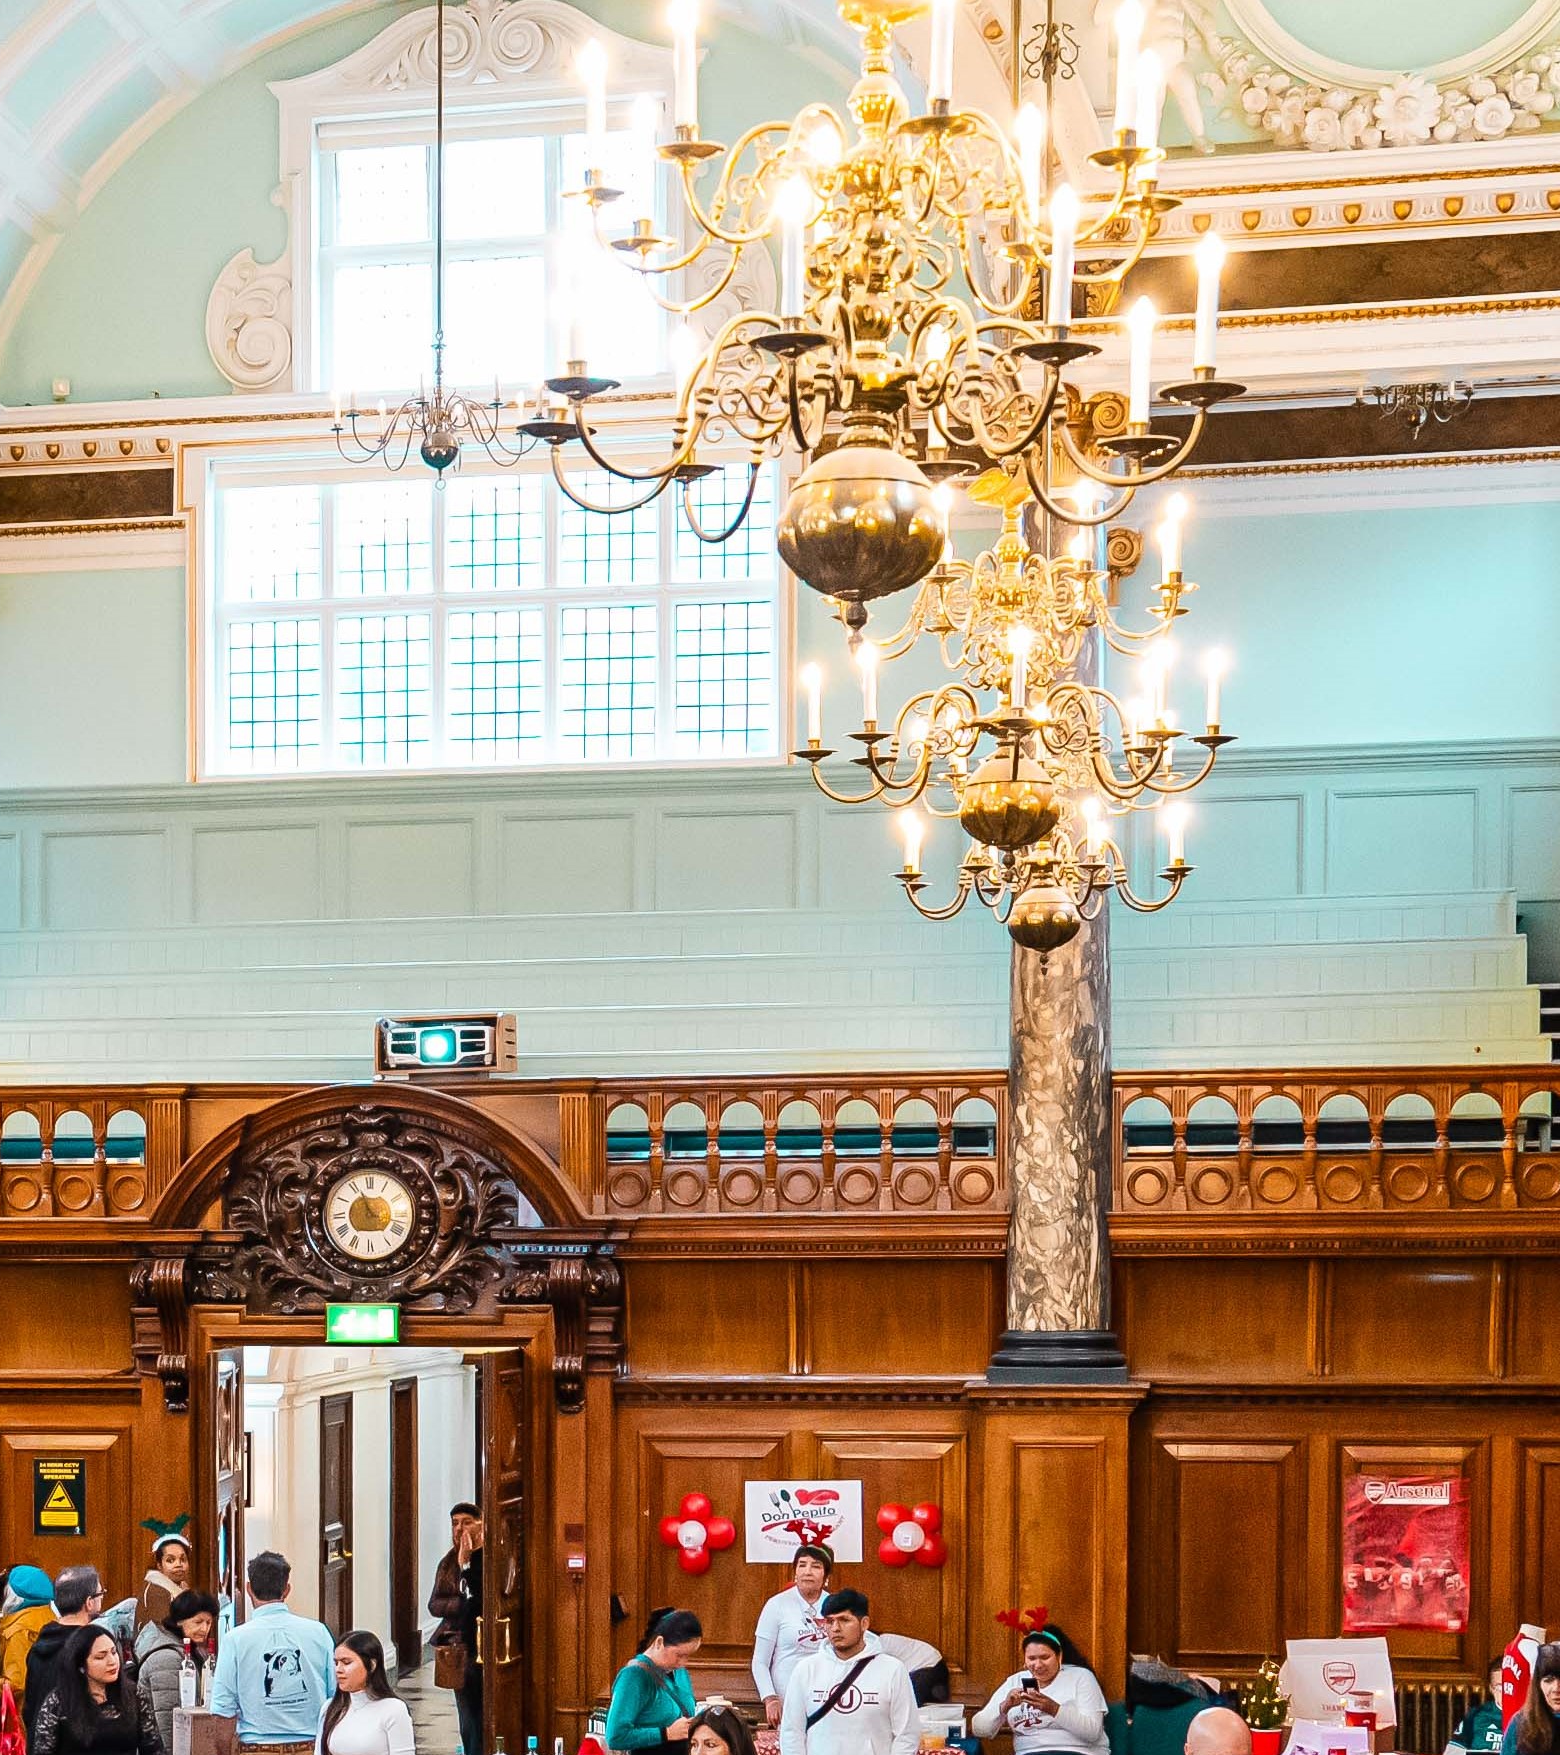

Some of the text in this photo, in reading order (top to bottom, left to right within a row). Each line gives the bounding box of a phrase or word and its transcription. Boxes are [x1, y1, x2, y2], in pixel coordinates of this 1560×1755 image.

[1387, 1482, 1449, 1499] Arsenal
[762, 1507, 836, 1523] Don Pepito
